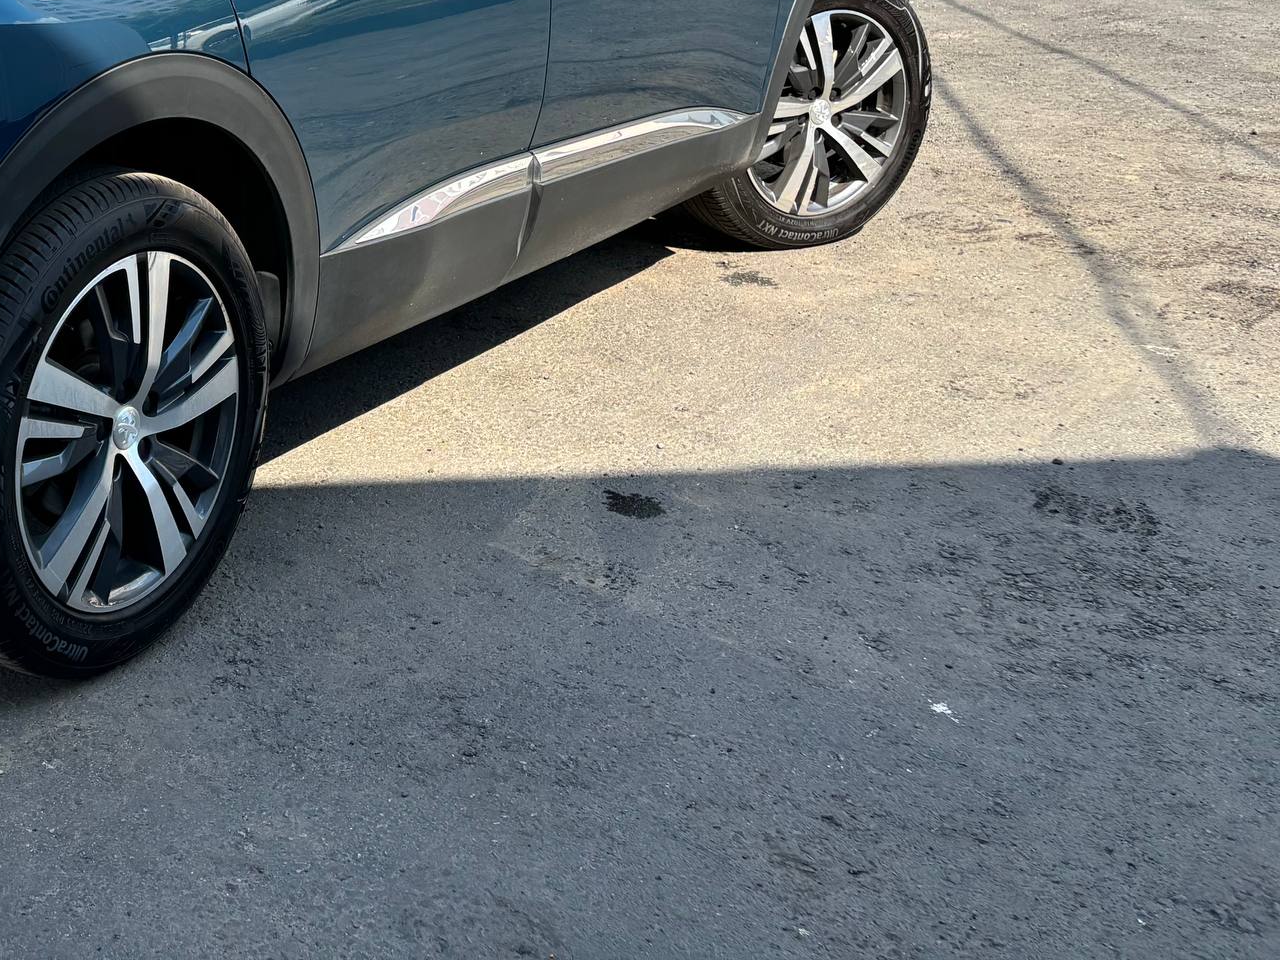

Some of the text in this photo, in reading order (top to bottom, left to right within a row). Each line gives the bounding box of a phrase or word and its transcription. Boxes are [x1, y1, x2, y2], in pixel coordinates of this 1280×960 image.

[757, 220, 839, 242] UltraContact NXT
[41, 217, 129, 314] Continental
[14, 603, 89, 662] UltraContact
